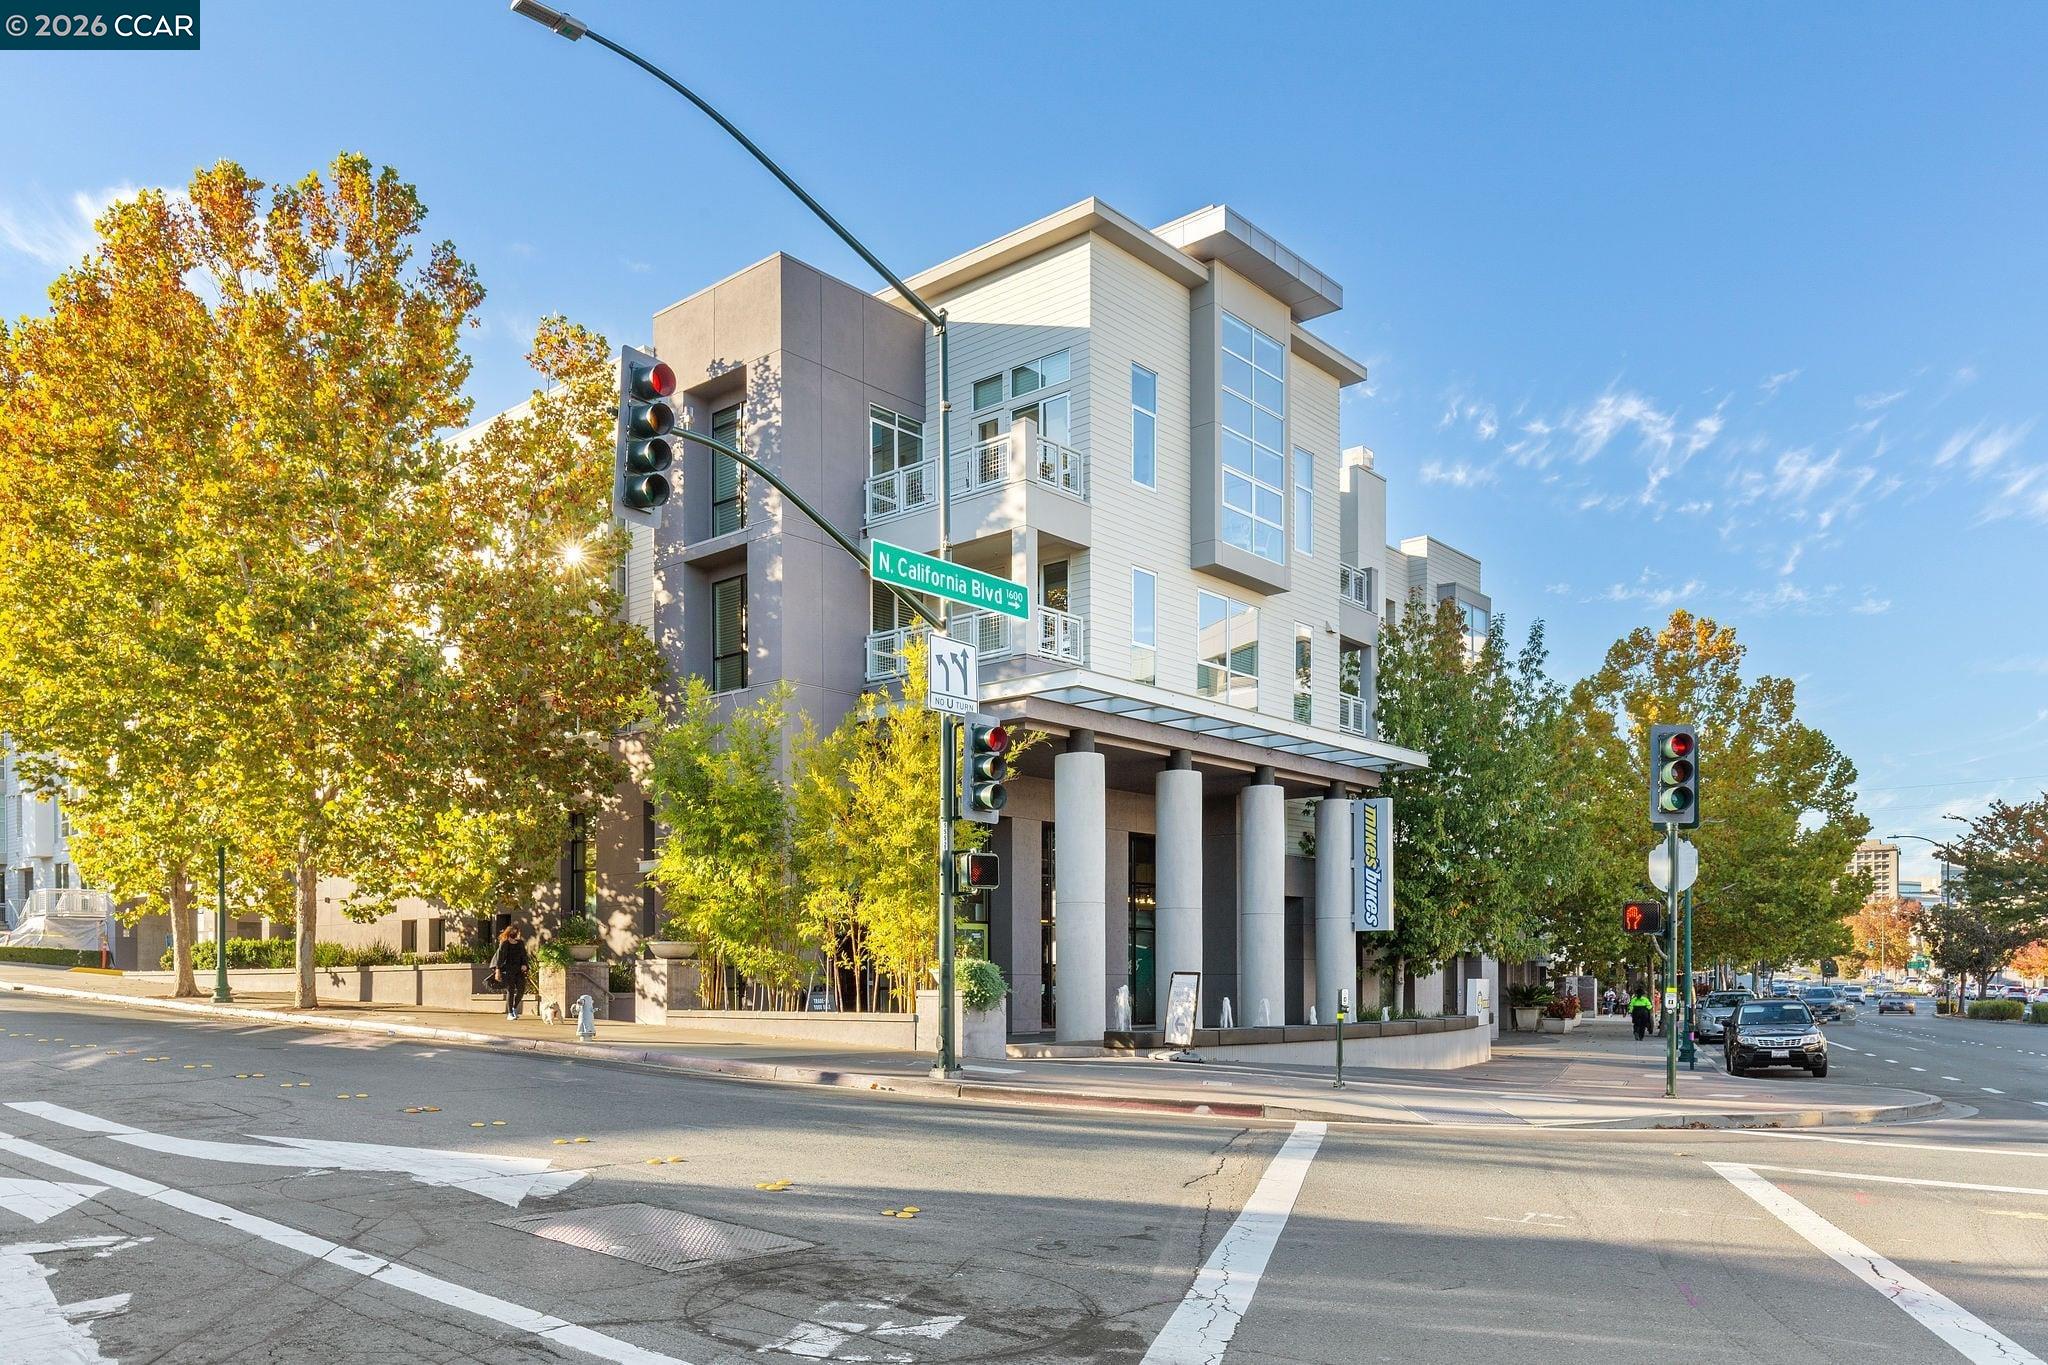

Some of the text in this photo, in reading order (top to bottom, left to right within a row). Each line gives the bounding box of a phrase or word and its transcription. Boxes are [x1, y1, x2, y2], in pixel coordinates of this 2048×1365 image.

[879, 550, 1004, 605] N. California Blvd
[1006, 588, 1023, 603] 1600
[935, 697, 974, 711] NO U TURN
